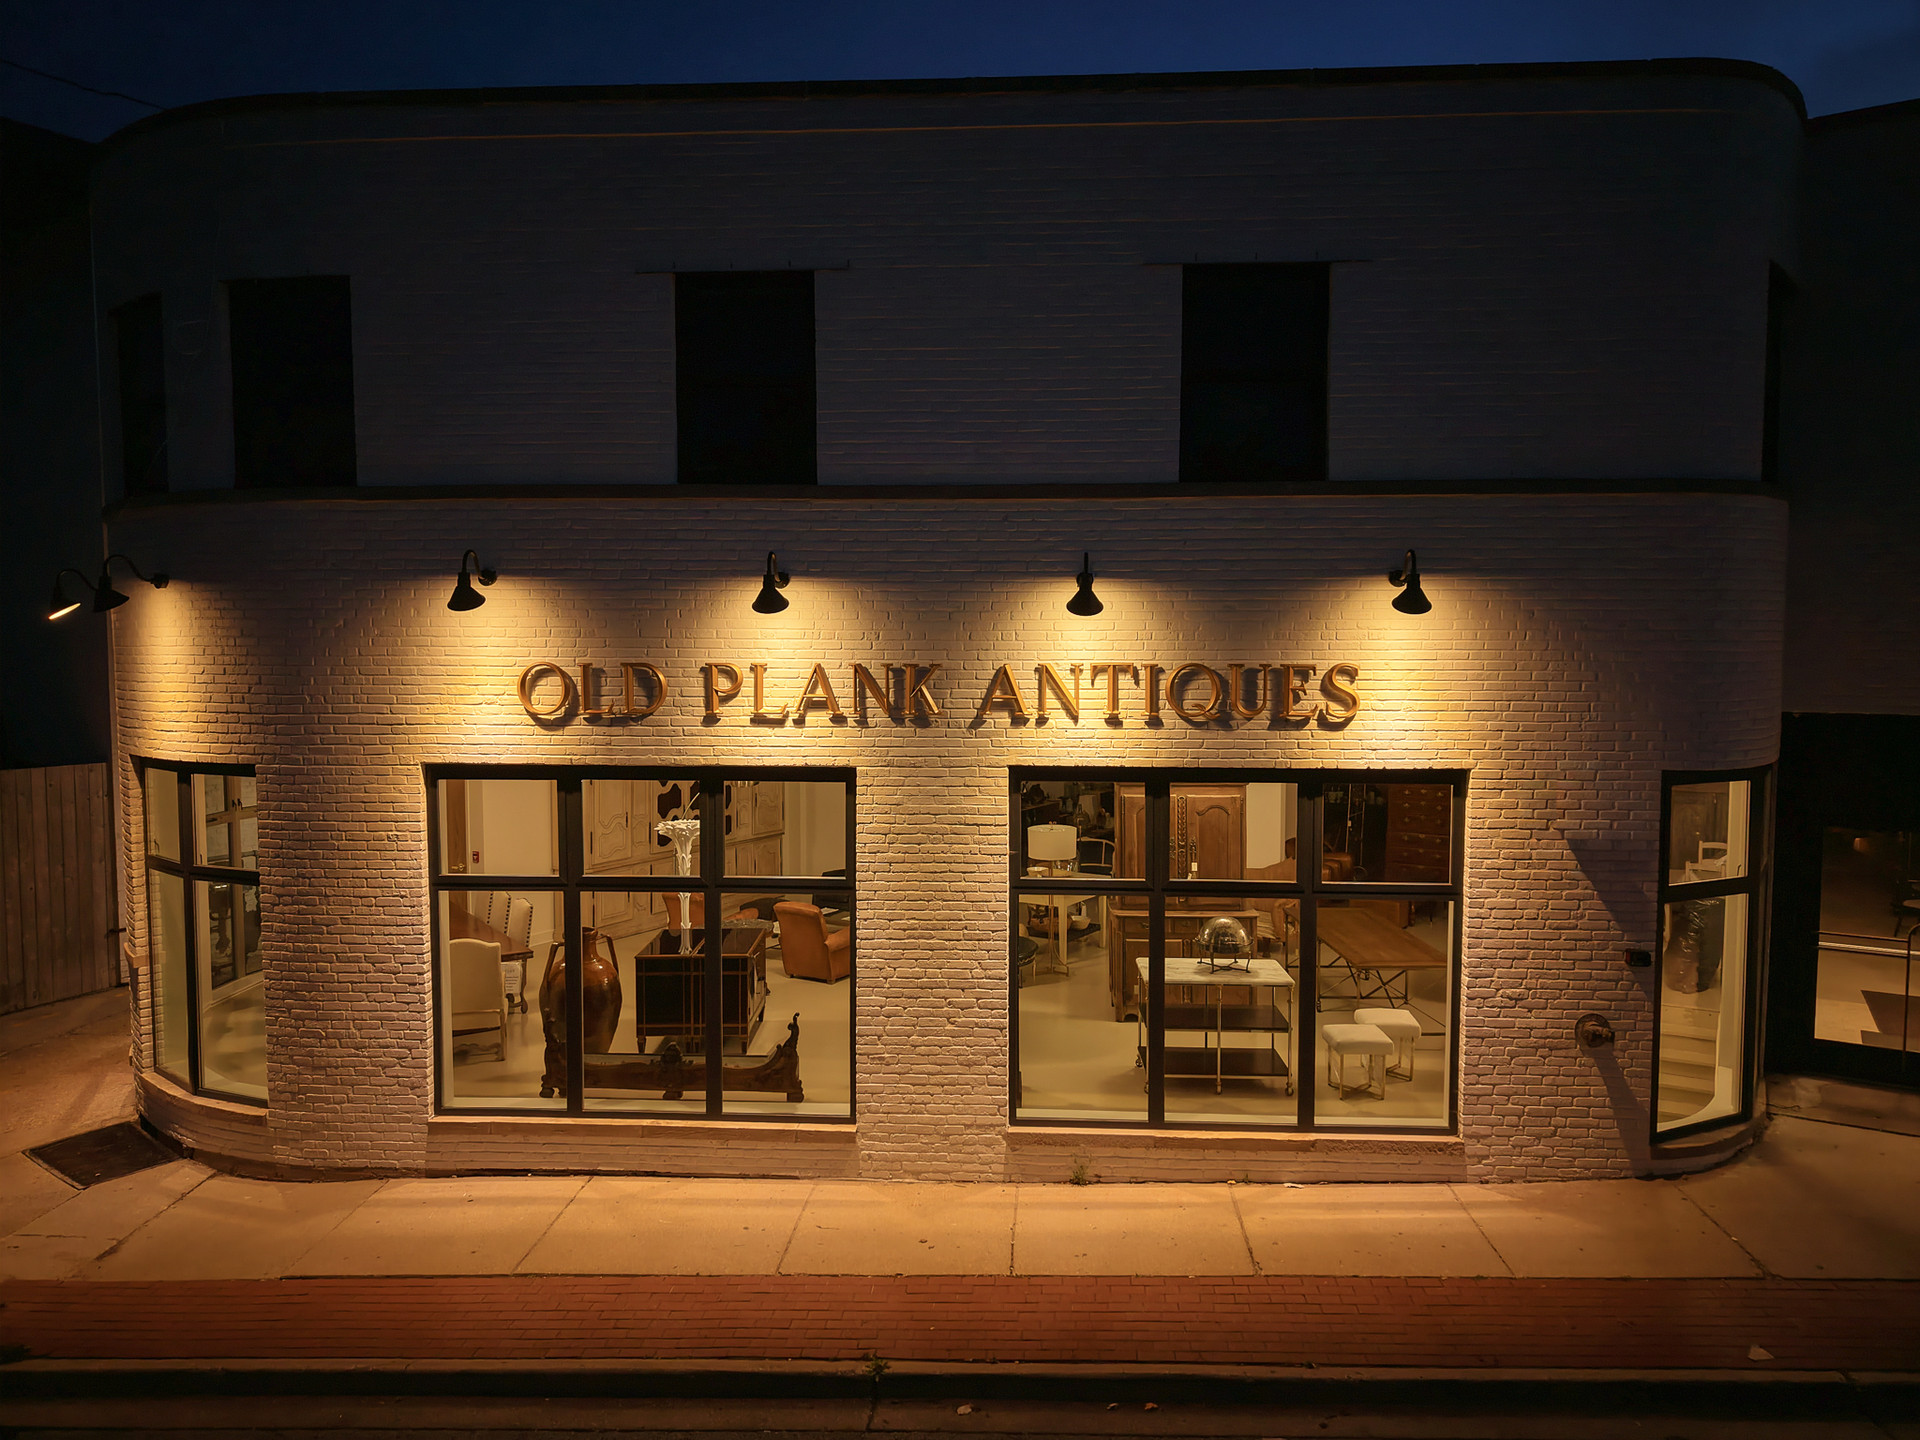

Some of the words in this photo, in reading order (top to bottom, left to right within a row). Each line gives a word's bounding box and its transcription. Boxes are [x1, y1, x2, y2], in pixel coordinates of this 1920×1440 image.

[517, 662, 668, 715] OLD
[703, 662, 943, 716] PLANK
[980, 662, 1361, 719] ANTIQUES
